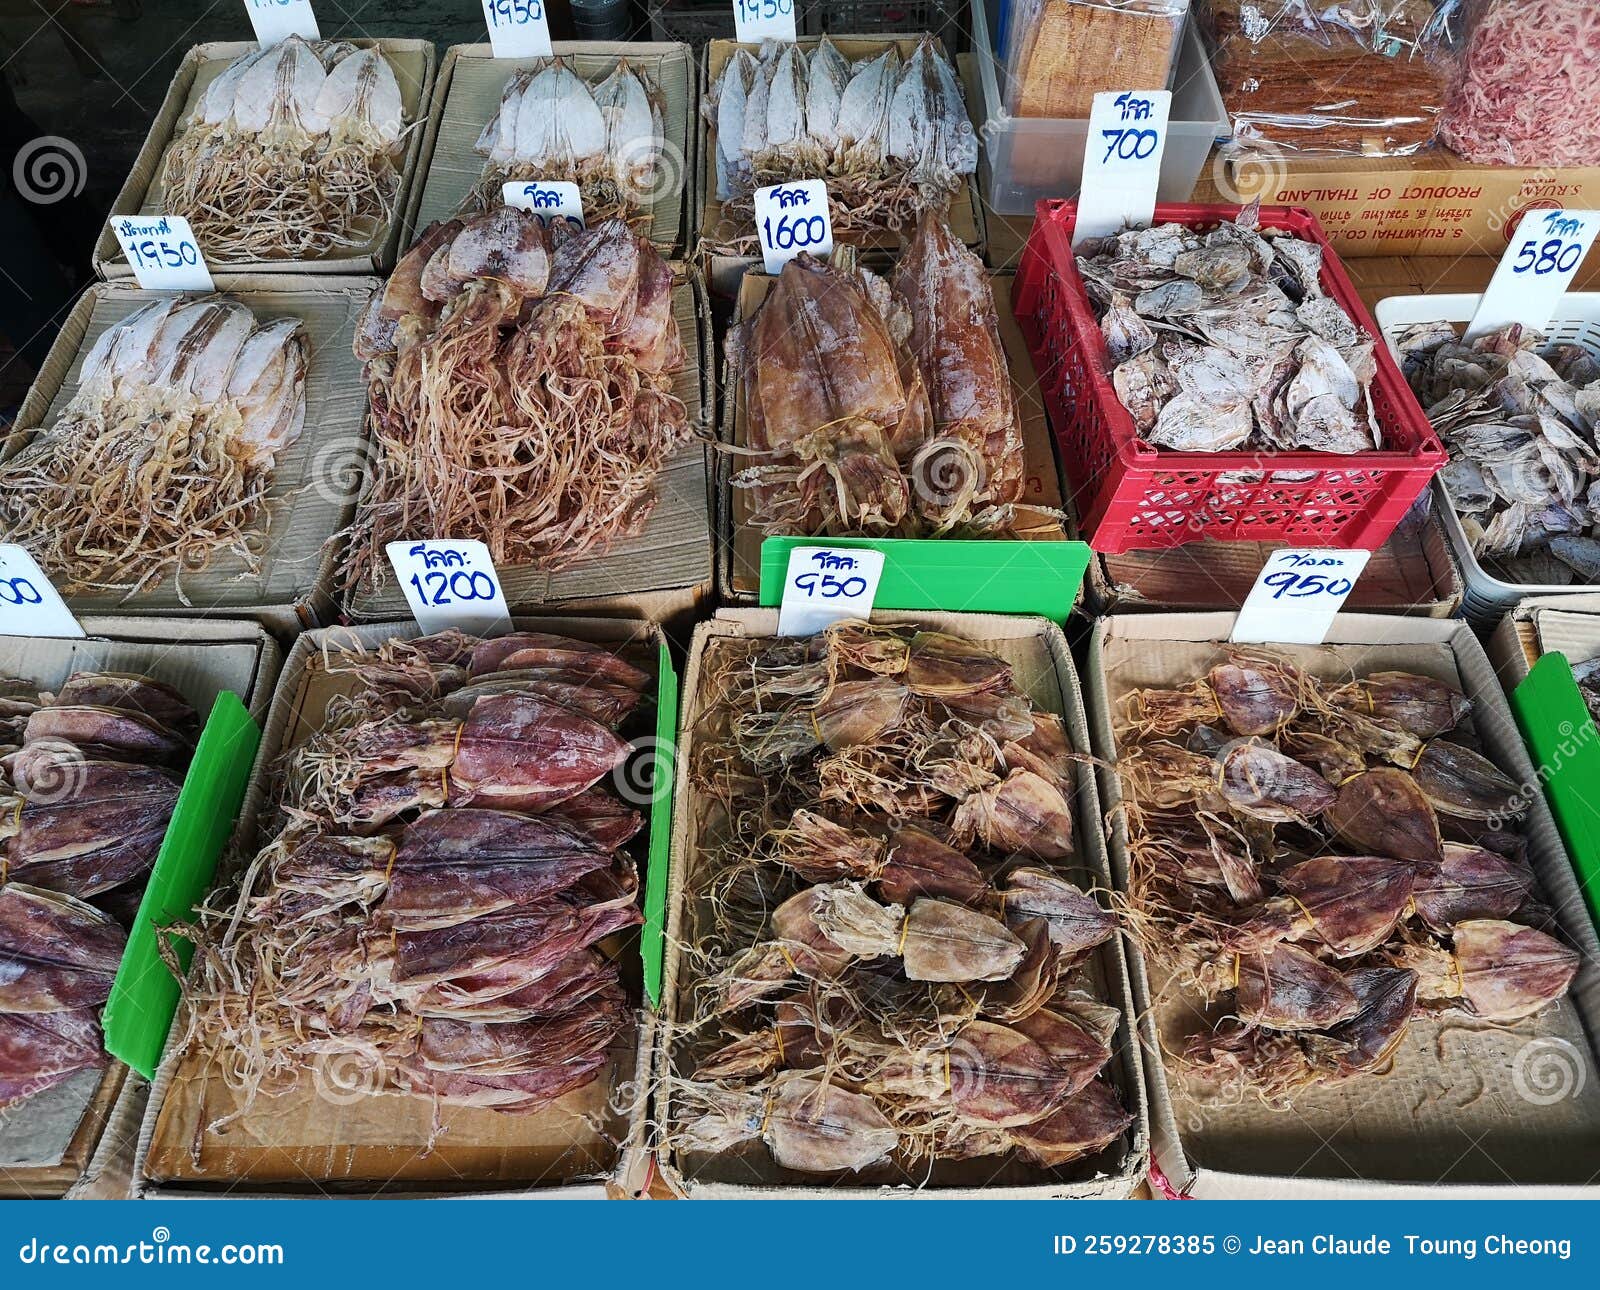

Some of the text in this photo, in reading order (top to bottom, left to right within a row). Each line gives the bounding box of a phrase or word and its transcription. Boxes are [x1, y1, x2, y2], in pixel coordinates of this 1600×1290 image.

[1102, 128, 1158, 164] 700
[1276, 186, 1482, 202] PRODUCT OF THAILAND
[1320, 210, 1351, 224] จำกัด
[1436, 208, 1472, 223] บริษัท
[1372, 228, 1447, 240] RUAMTHAI
[1451, 228, 1463, 238] S.
[1513, 239, 1582, 275] 580
[410, 543, 471, 569] โลละ
[812, 551, 859, 570] โลละ
[795, 573, 867, 597] 950
[1264, 571, 1352, 599] 950
